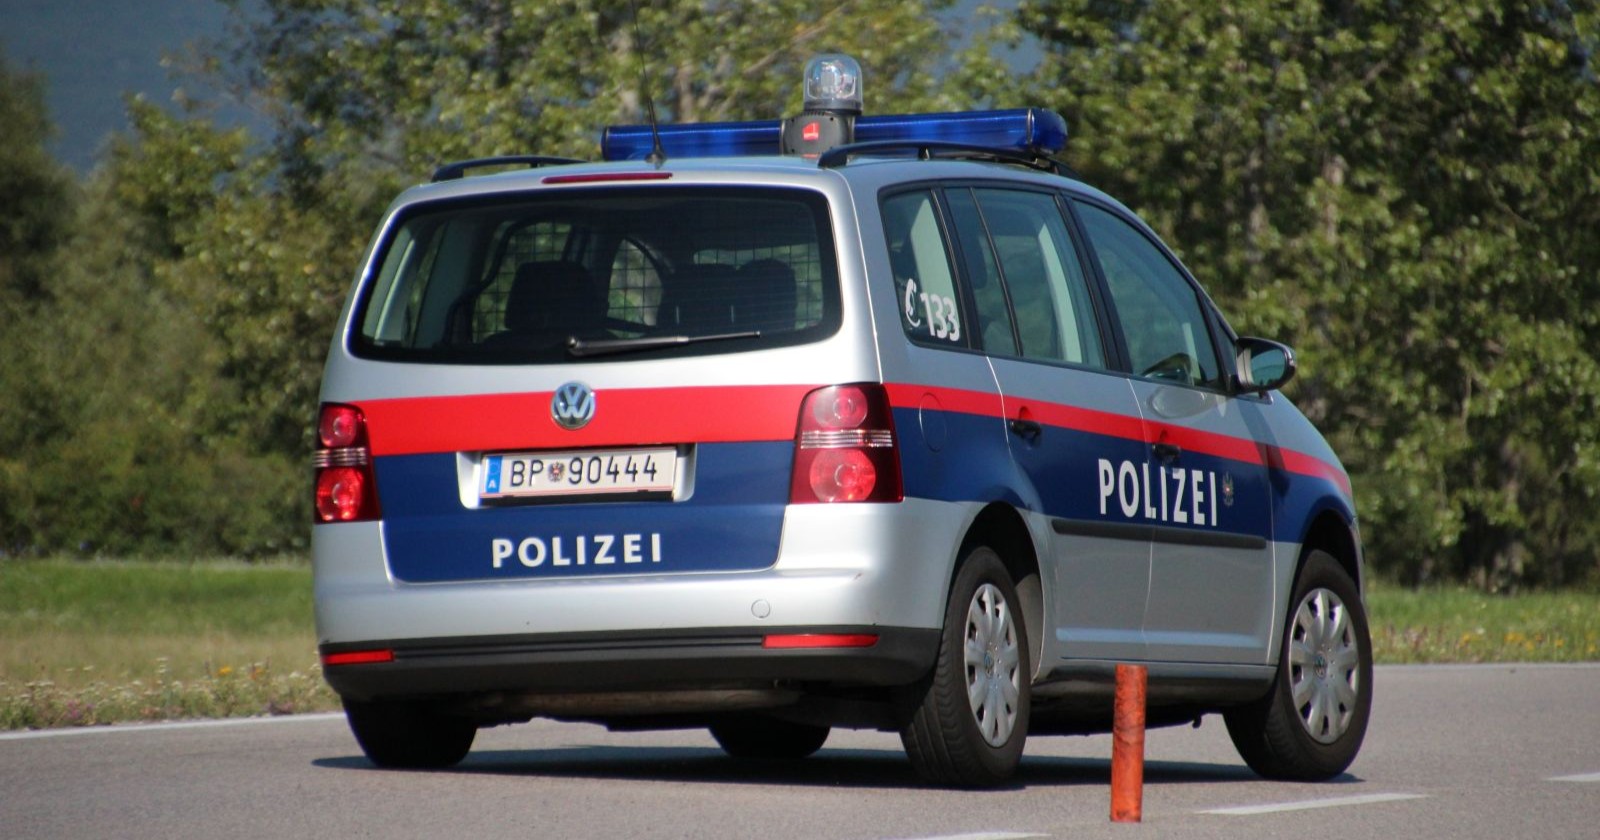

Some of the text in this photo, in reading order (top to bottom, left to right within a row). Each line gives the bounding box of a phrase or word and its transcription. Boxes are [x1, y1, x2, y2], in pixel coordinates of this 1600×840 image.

[920, 292, 960, 342] 133
[553, 383, 594, 422] VW
[487, 479, 497, 489] A
[510, 454, 658, 488] BP 90444
[1098, 458, 1218, 527] POLIZEI
[492, 533, 661, 568] POLIZEI
